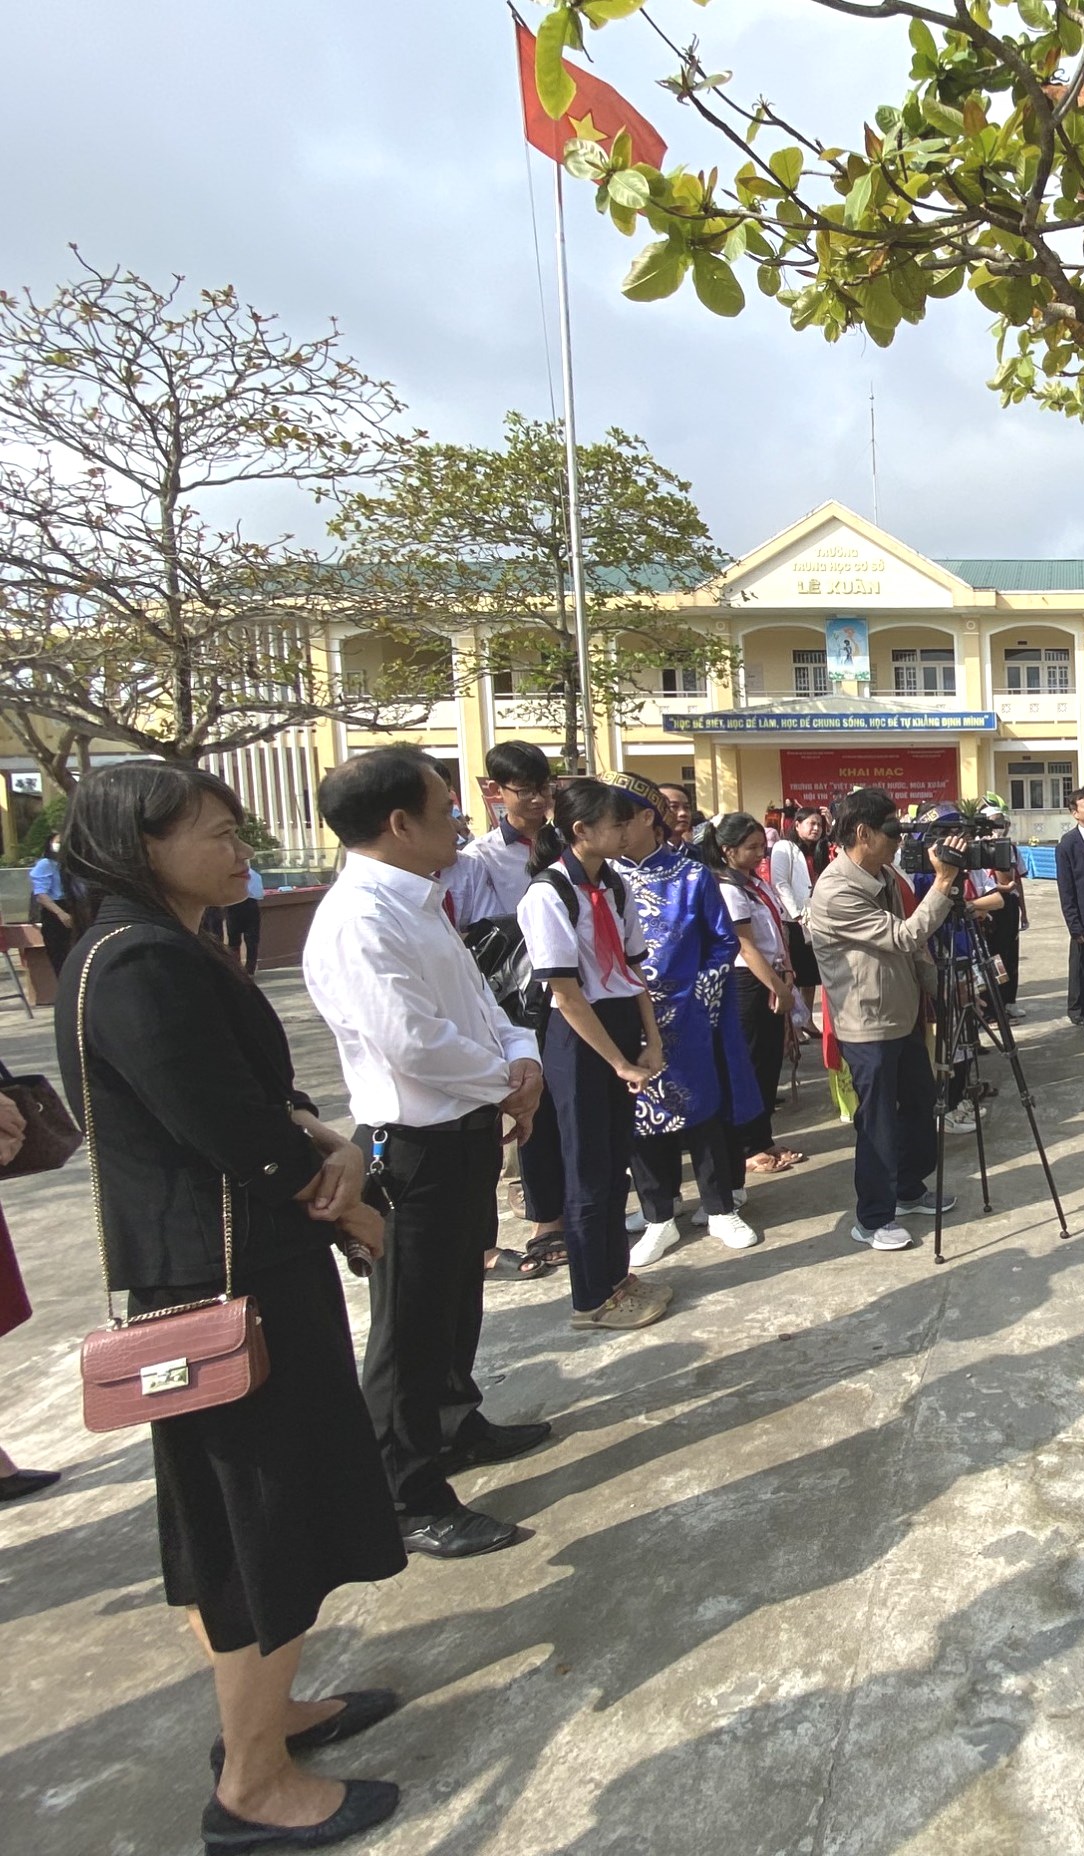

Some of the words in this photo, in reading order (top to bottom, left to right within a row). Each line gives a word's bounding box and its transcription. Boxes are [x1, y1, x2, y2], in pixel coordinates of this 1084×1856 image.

[792, 562, 827, 572] TRUNG
[829, 562, 851, 574] HỌC
[797, 579, 821, 594] LÊ
[827, 579, 881, 594] XUÂN
[727, 717, 745, 730] HỌC
[758, 716, 780, 729] LÀM,
[781, 717, 798, 730] HỌC
[800, 715, 811, 728] ĐỂ
[812, 717, 841, 728] CHUNG
[842, 715, 868, 728] SỐNG,
[869, 717, 886, 730] HỌC
[887, 715, 899, 728] ĐỂ
[900, 717, 911, 729] TỰ
[838, 767, 870, 777] KHAI
[873, 767, 904, 779] MẠC
